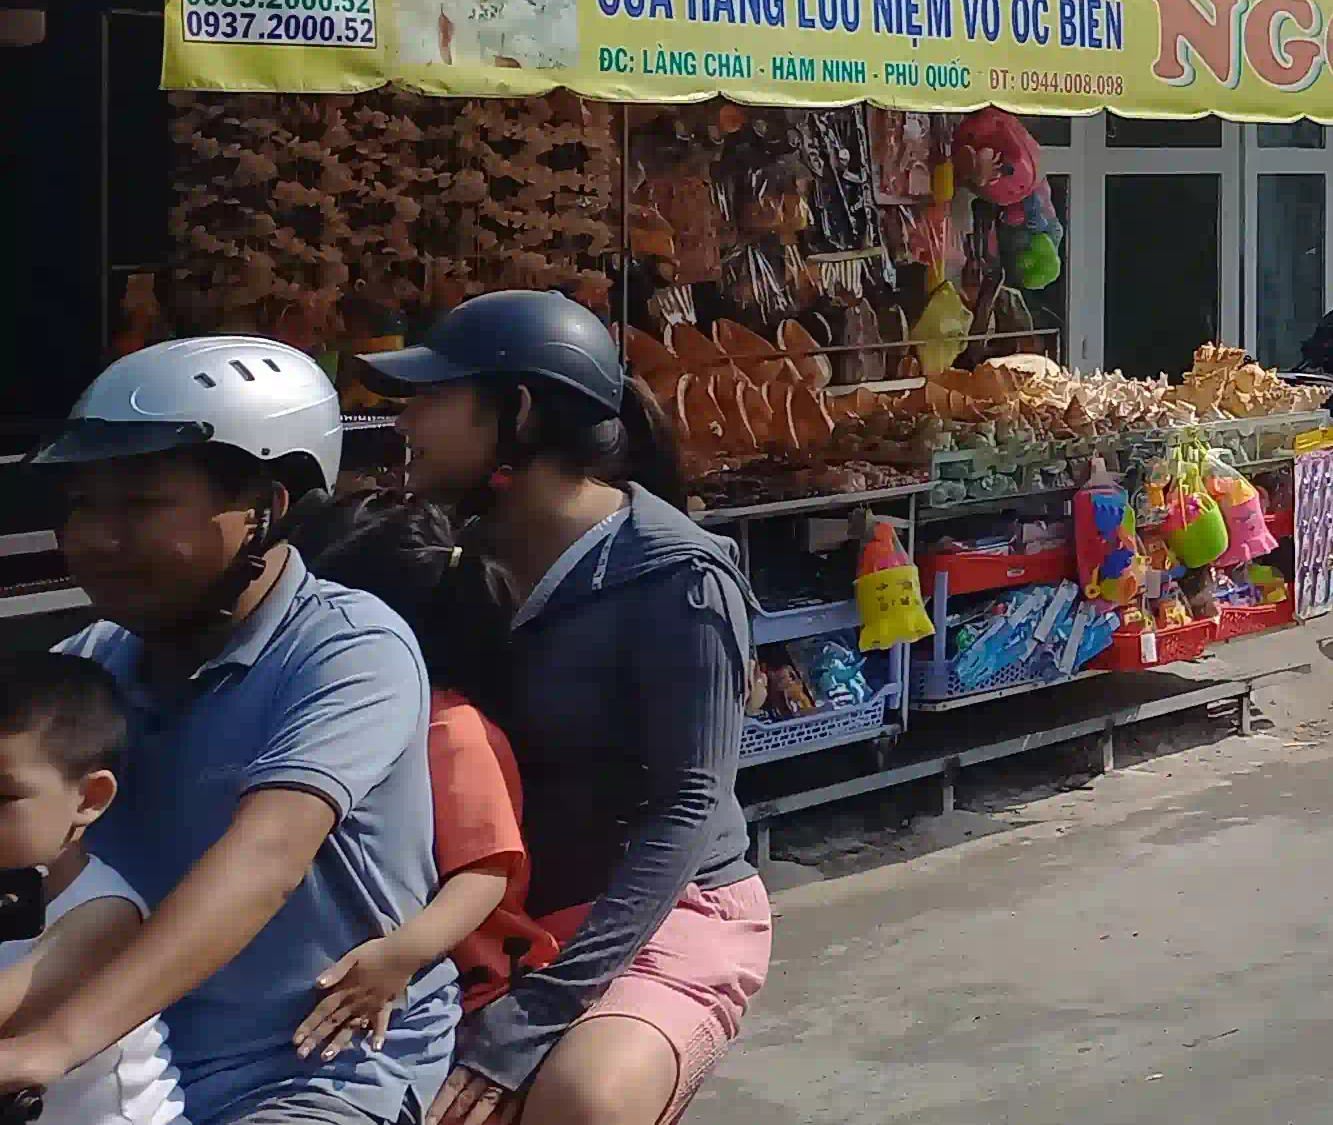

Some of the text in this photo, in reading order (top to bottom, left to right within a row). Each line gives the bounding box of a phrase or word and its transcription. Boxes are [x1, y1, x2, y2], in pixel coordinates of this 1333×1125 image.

[186, 10, 374, 43] 0937.2000.52
[599, 47, 635, 73] ĐC:
[641, 43, 697, 76] LÀNG
[703, 46, 752, 79] CHÀI
[771, 51, 815, 83] HÀM
[822, 59, 867, 84] NINH
[884, 58, 919, 87] PHÚ
[925, 58, 972, 91] QUỐC
[989, 68, 1016, 91] ĐT:
